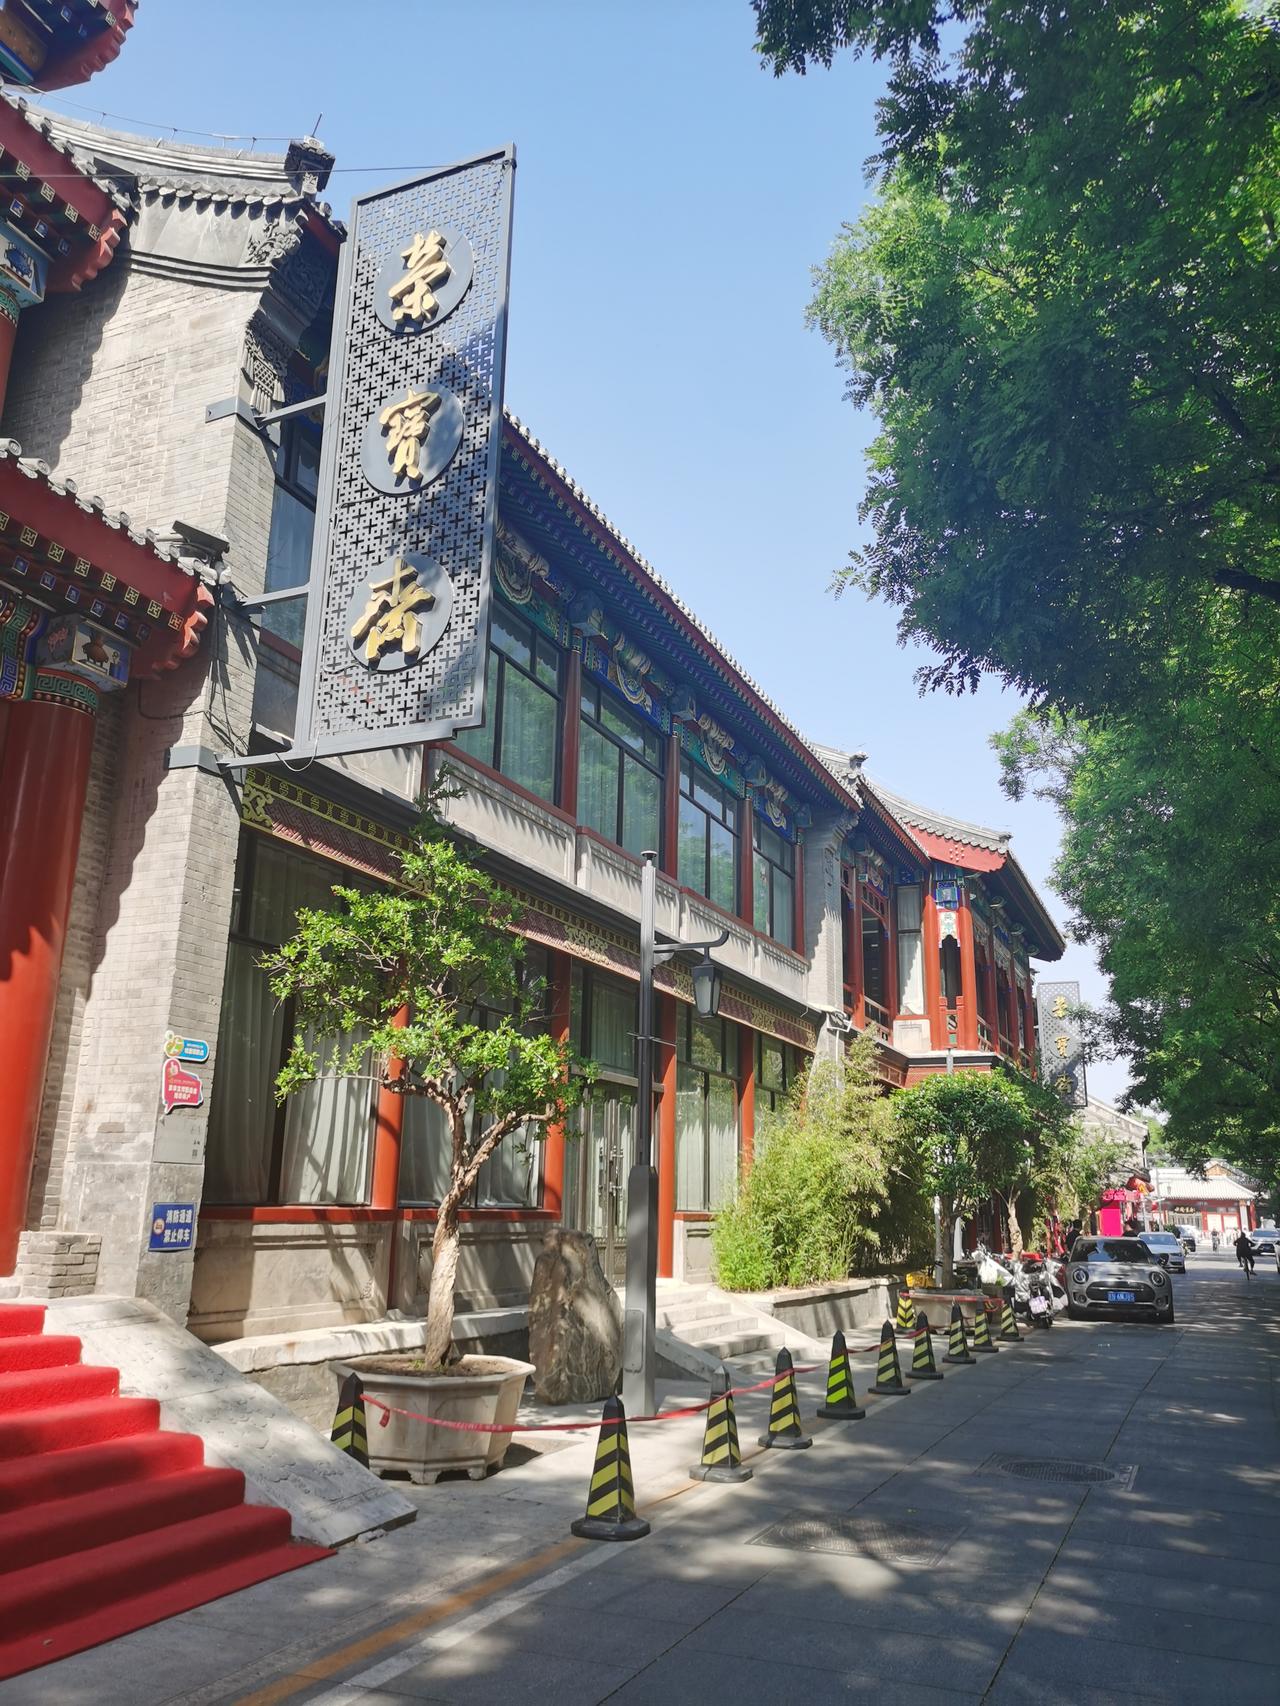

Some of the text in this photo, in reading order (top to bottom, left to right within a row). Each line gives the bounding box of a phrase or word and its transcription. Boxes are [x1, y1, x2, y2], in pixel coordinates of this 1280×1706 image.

[166, 1209, 192, 1224] 消防通道
[163, 1228, 190, 1243] 禁止停车
